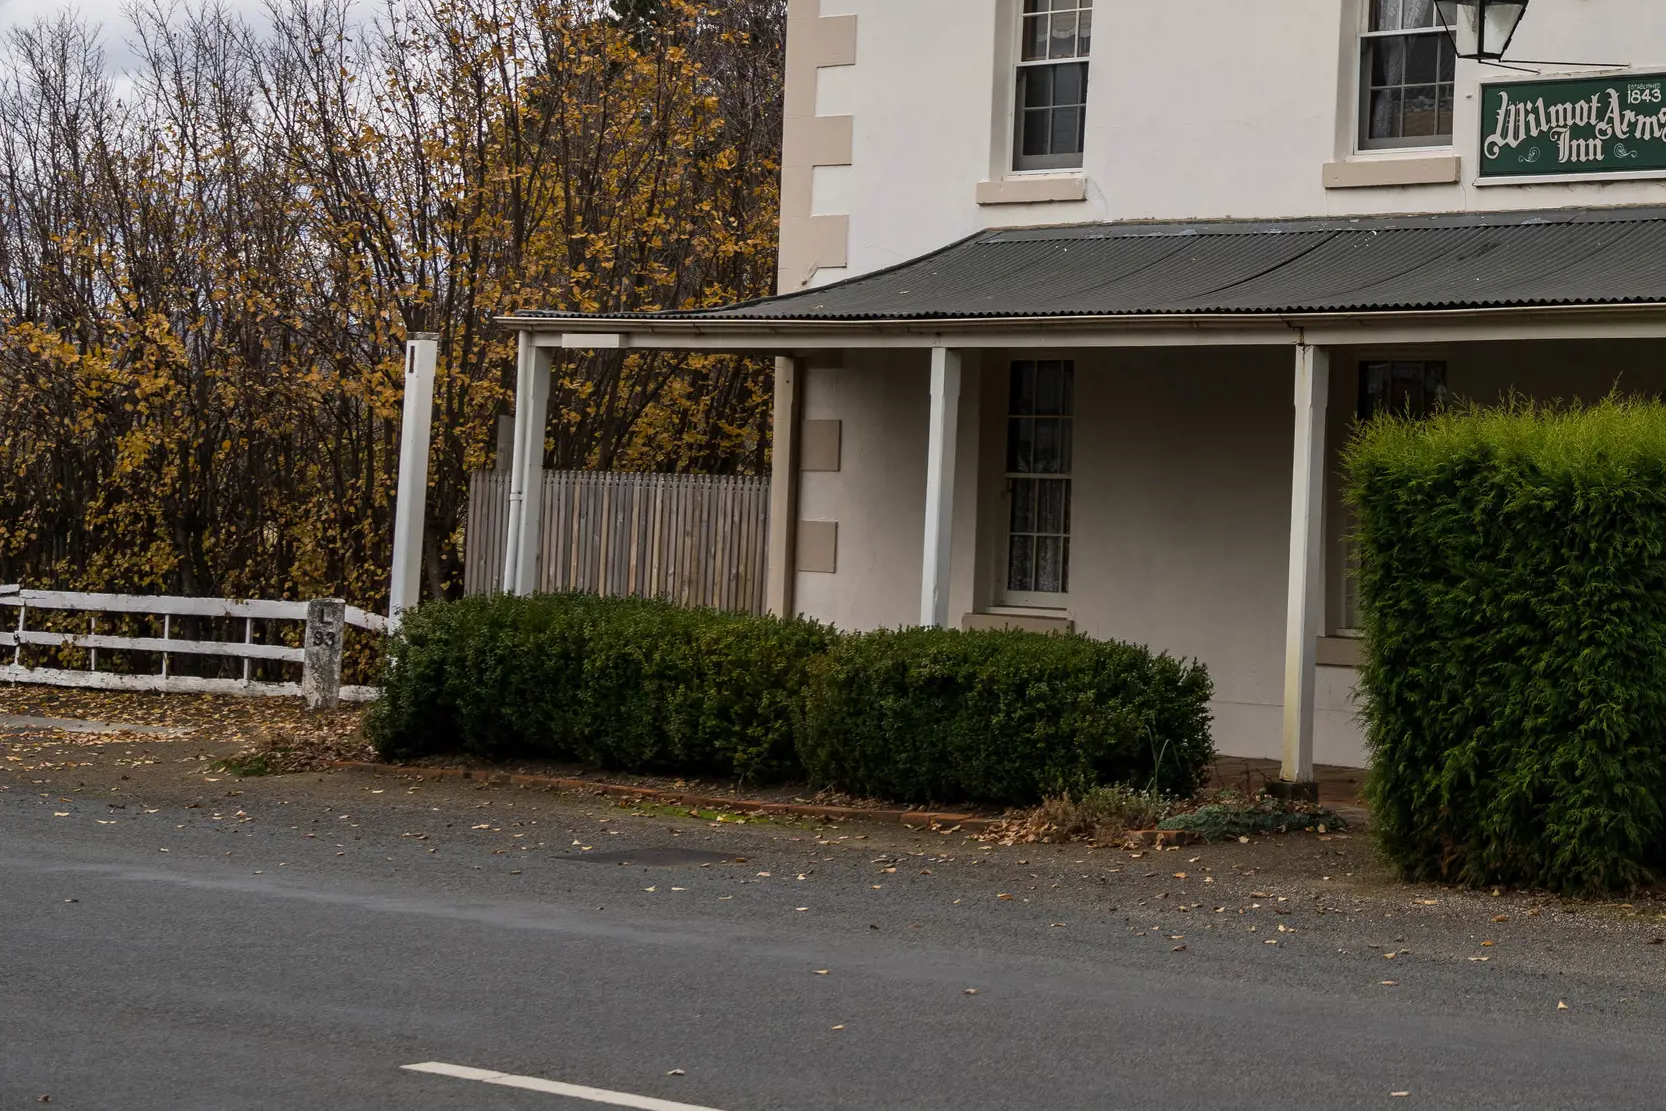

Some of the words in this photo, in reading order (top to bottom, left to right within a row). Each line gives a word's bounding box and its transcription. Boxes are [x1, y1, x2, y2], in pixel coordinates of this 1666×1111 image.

[1627, 89, 1662, 104] 1843
[1484, 91, 1601, 159] Wilmot
[1549, 126, 1605, 163] Inn
[320, 608, 332, 624] L
